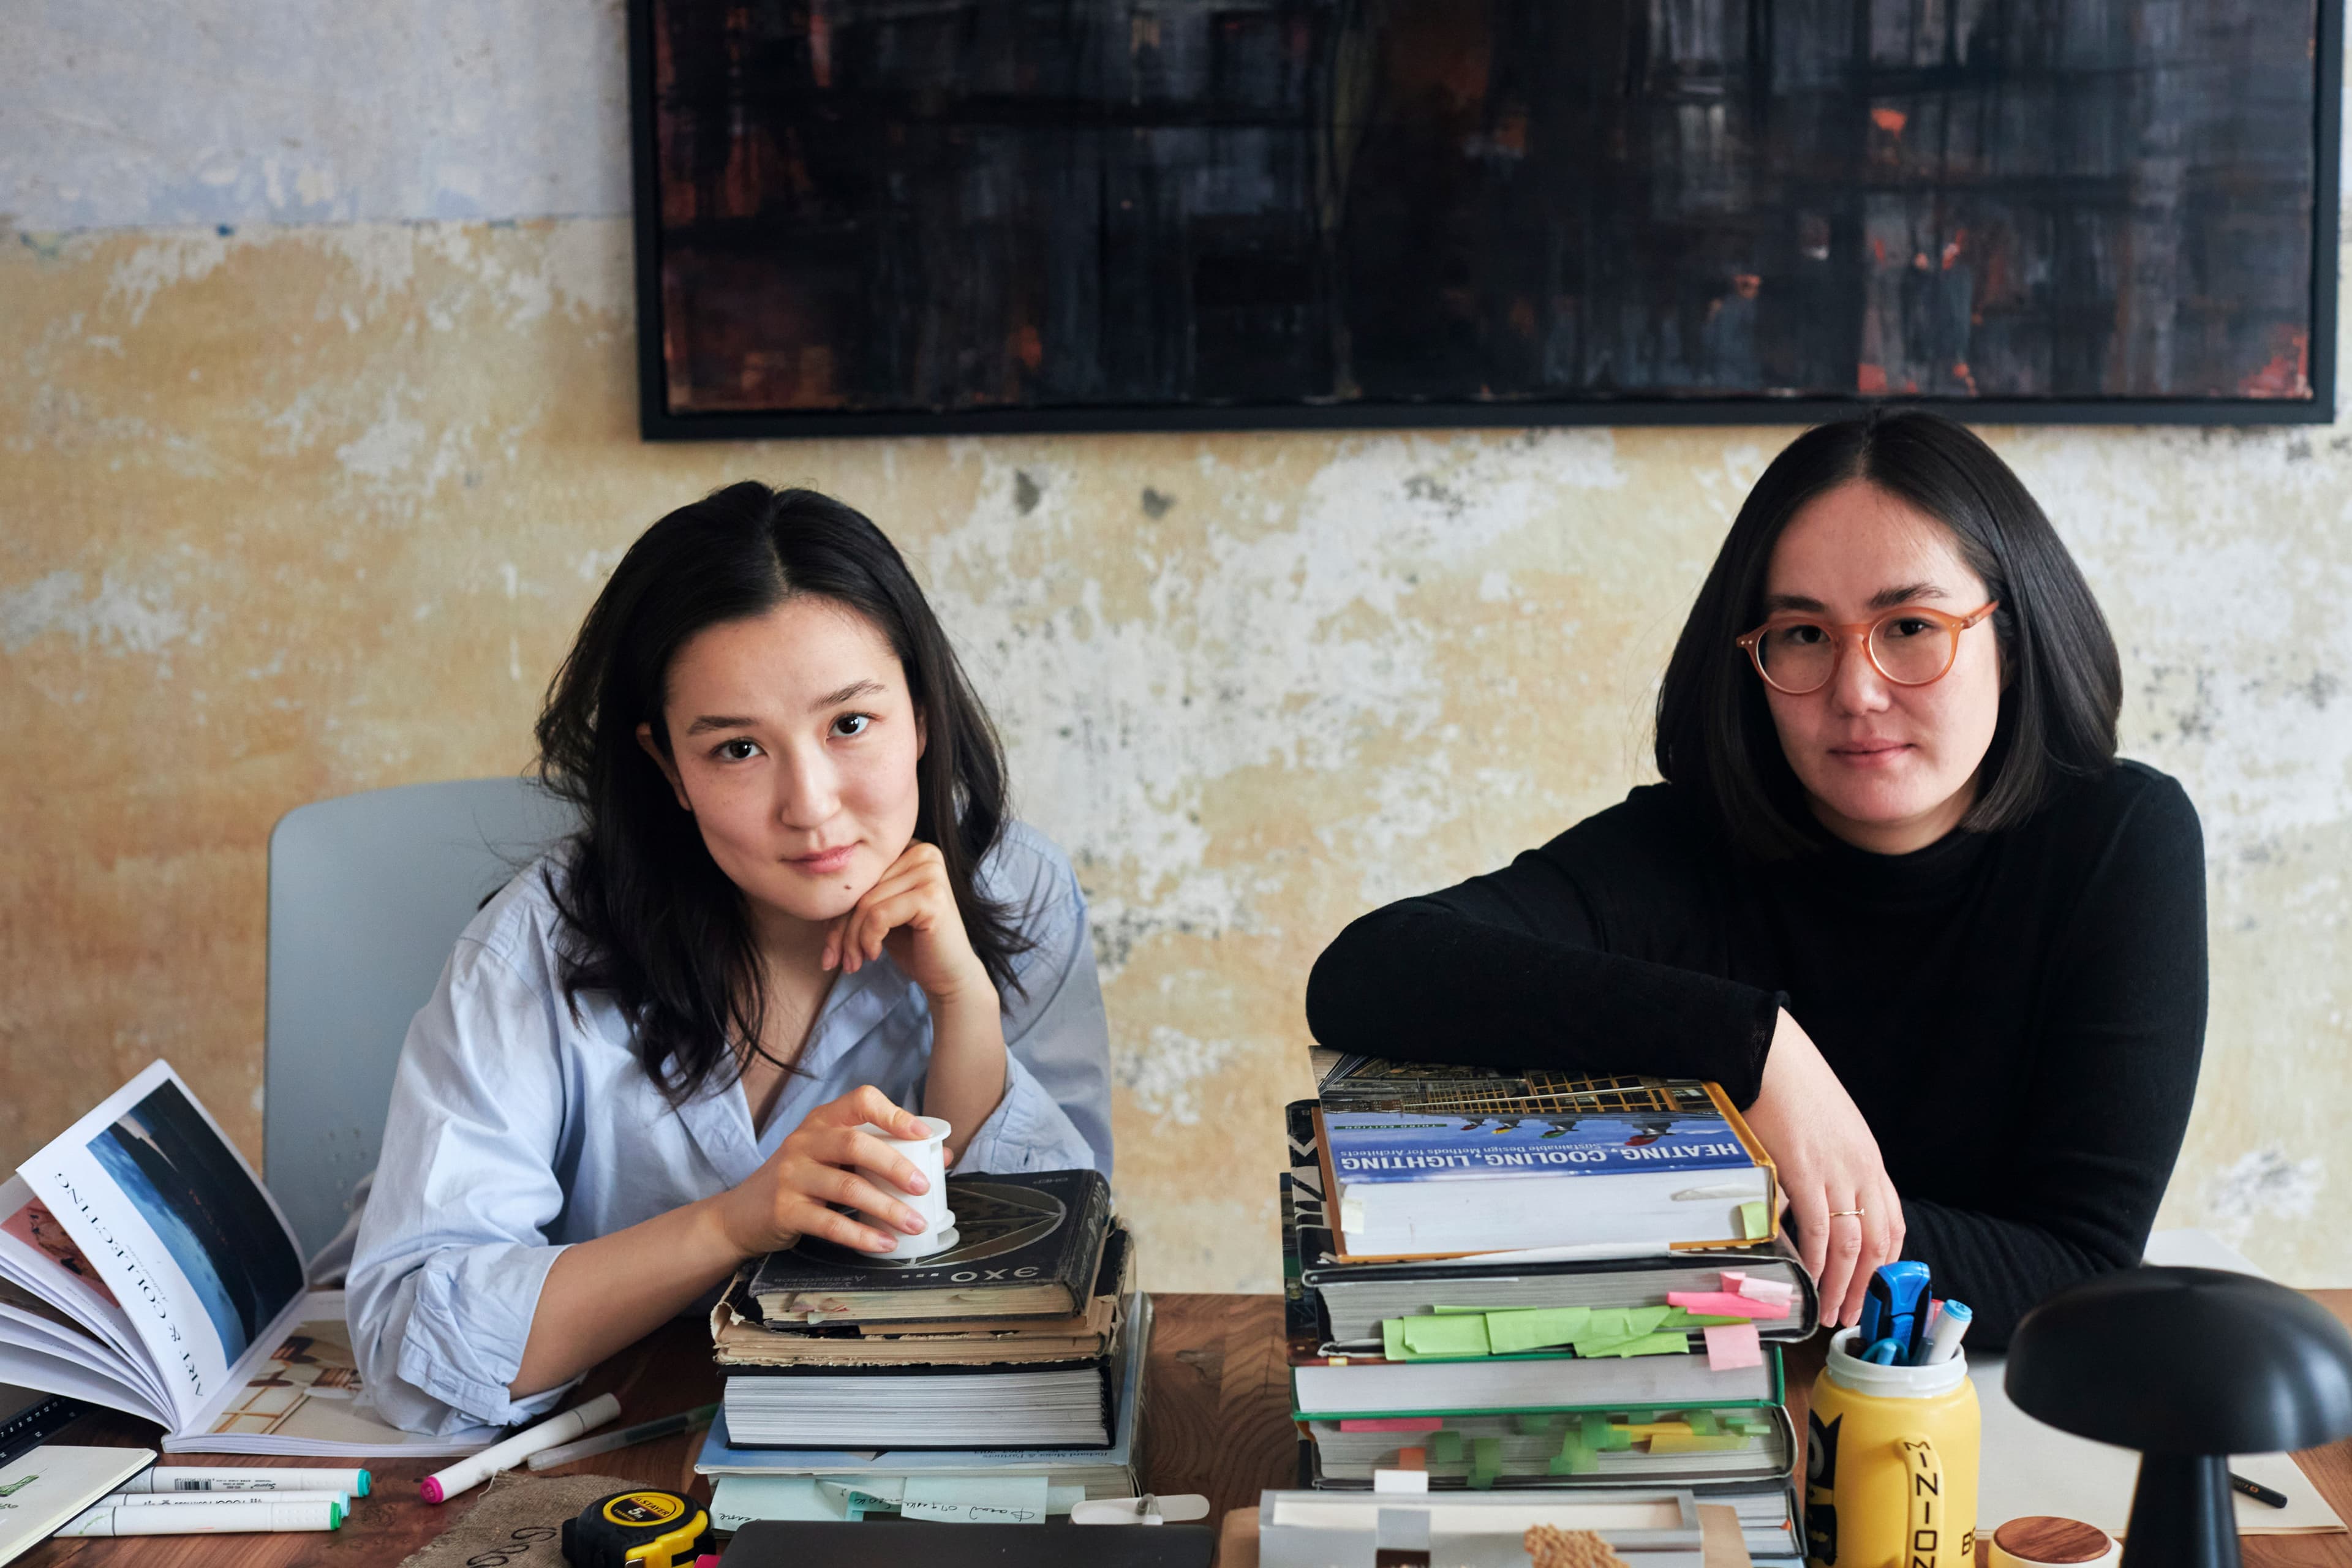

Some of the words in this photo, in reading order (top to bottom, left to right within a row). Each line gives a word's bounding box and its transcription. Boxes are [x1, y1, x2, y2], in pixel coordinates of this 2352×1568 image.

[1341, 1149, 1404, 1158] Architects
[1426, 1147, 1479, 1155] Methods
[1481, 1144, 1526, 1155] Design
[1529, 1142, 1602, 1153] Sustainable
[1611, 1142, 1740, 1162] HEATING,
[1341, 1155, 1470, 1170] LIGHTING
[1474, 1148, 1608, 1167] COOLING,
[54, 1172, 167, 1319] COLLECTING
[168, 1323, 181, 1343] &
[178, 1349, 203, 1397] ART
[640, 1499, 671, 1516] STAYER
